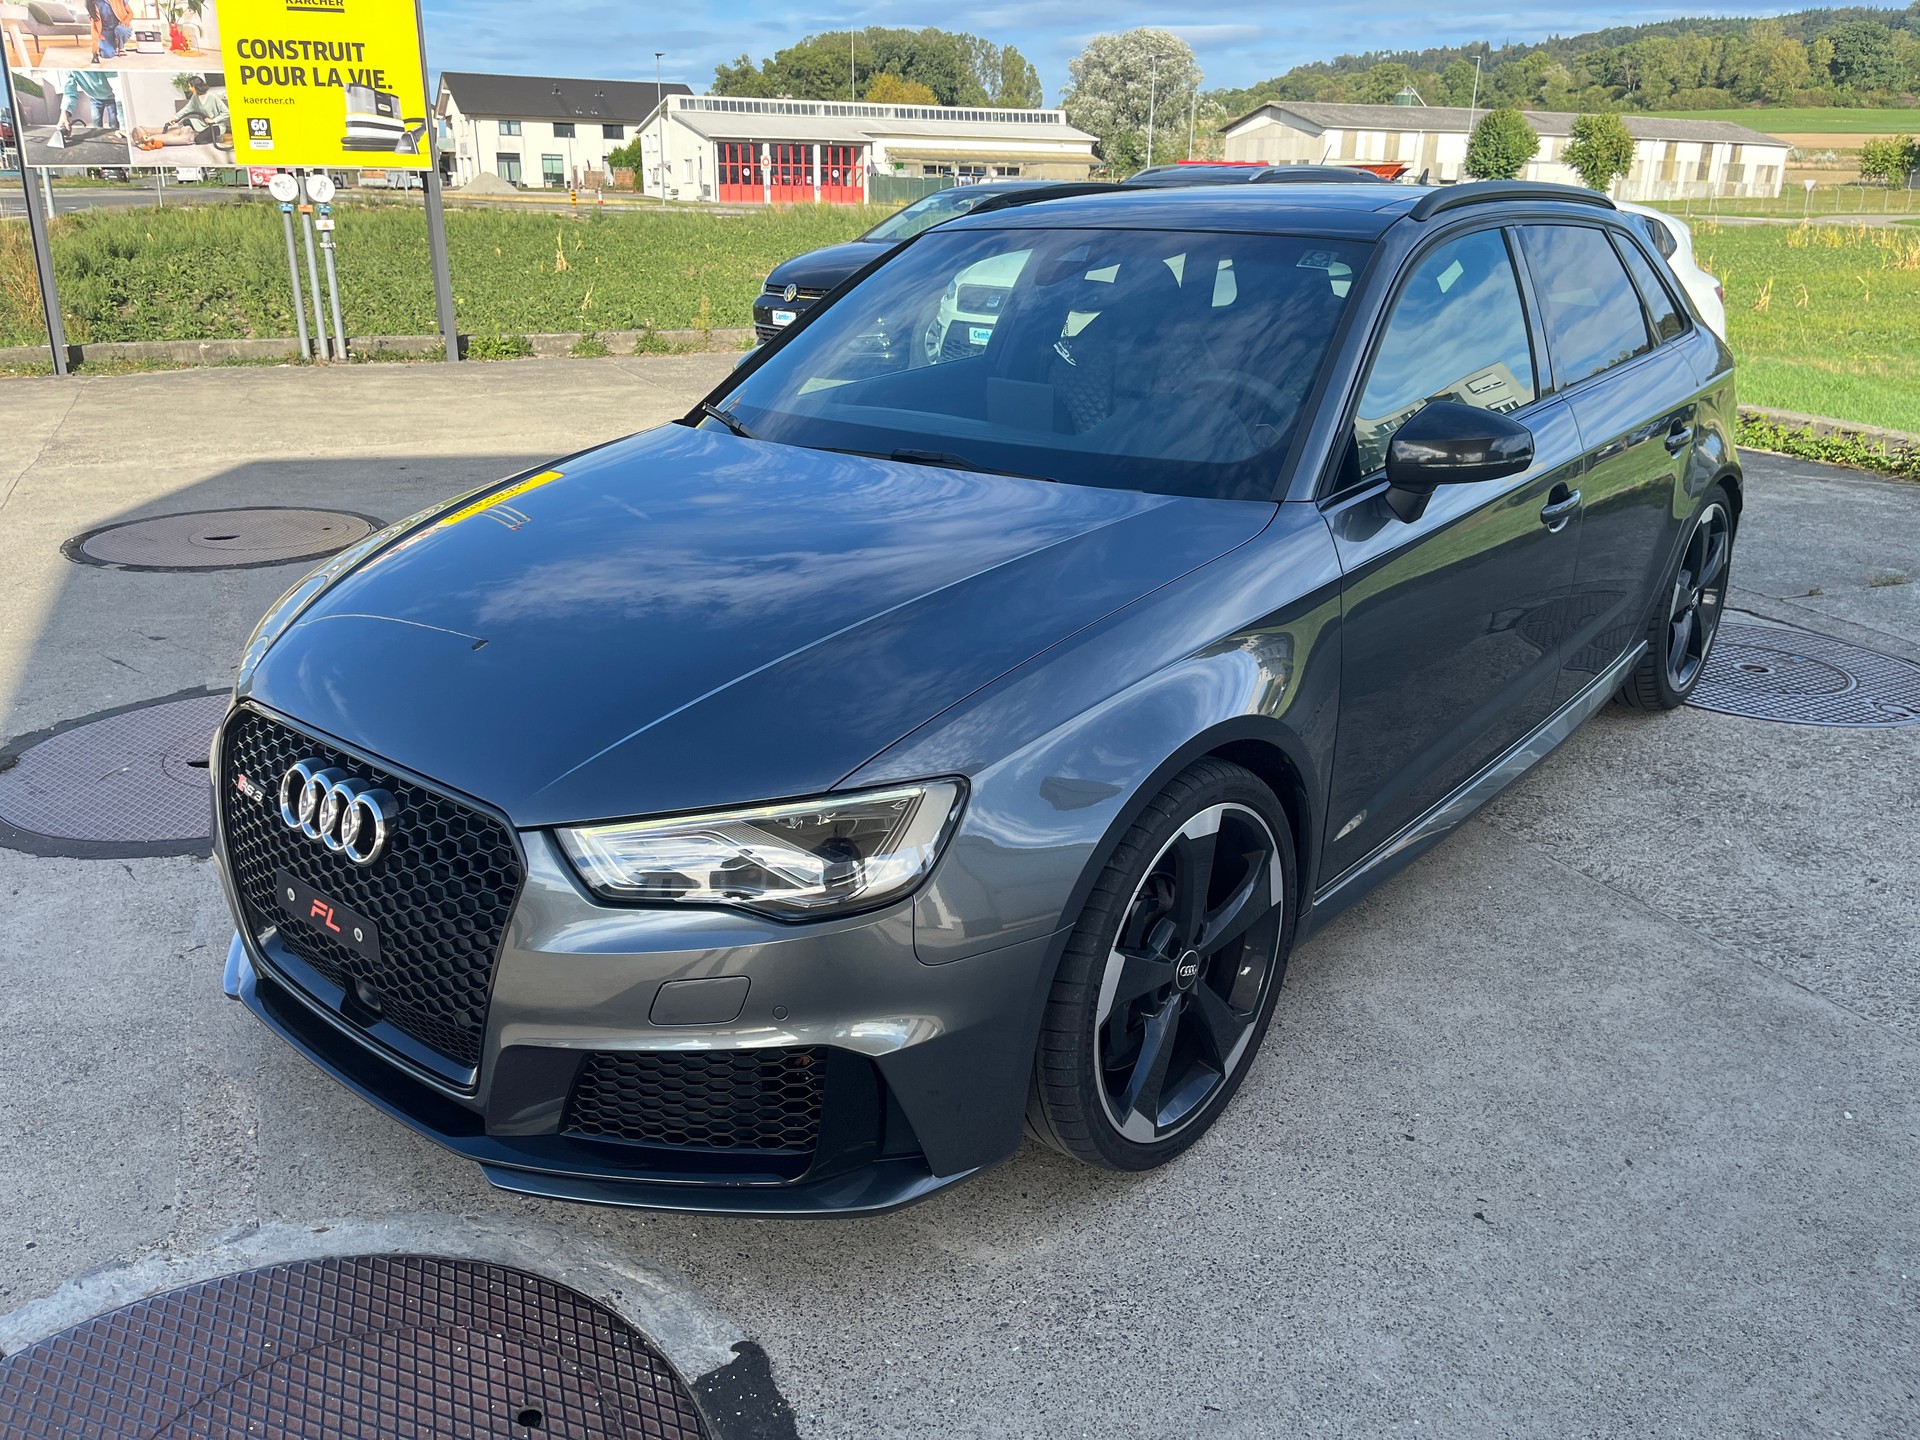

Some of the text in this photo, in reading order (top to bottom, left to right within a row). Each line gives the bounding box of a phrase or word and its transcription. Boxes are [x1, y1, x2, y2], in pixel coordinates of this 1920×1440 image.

[237, 39, 365, 62] CONSTRUIT
[240, 65, 393, 90] POUR LA VIE.
[243, 96, 295, 105] kaercher.ch
[250, 119, 268, 131] 60
[310, 899, 341, 933] FL
